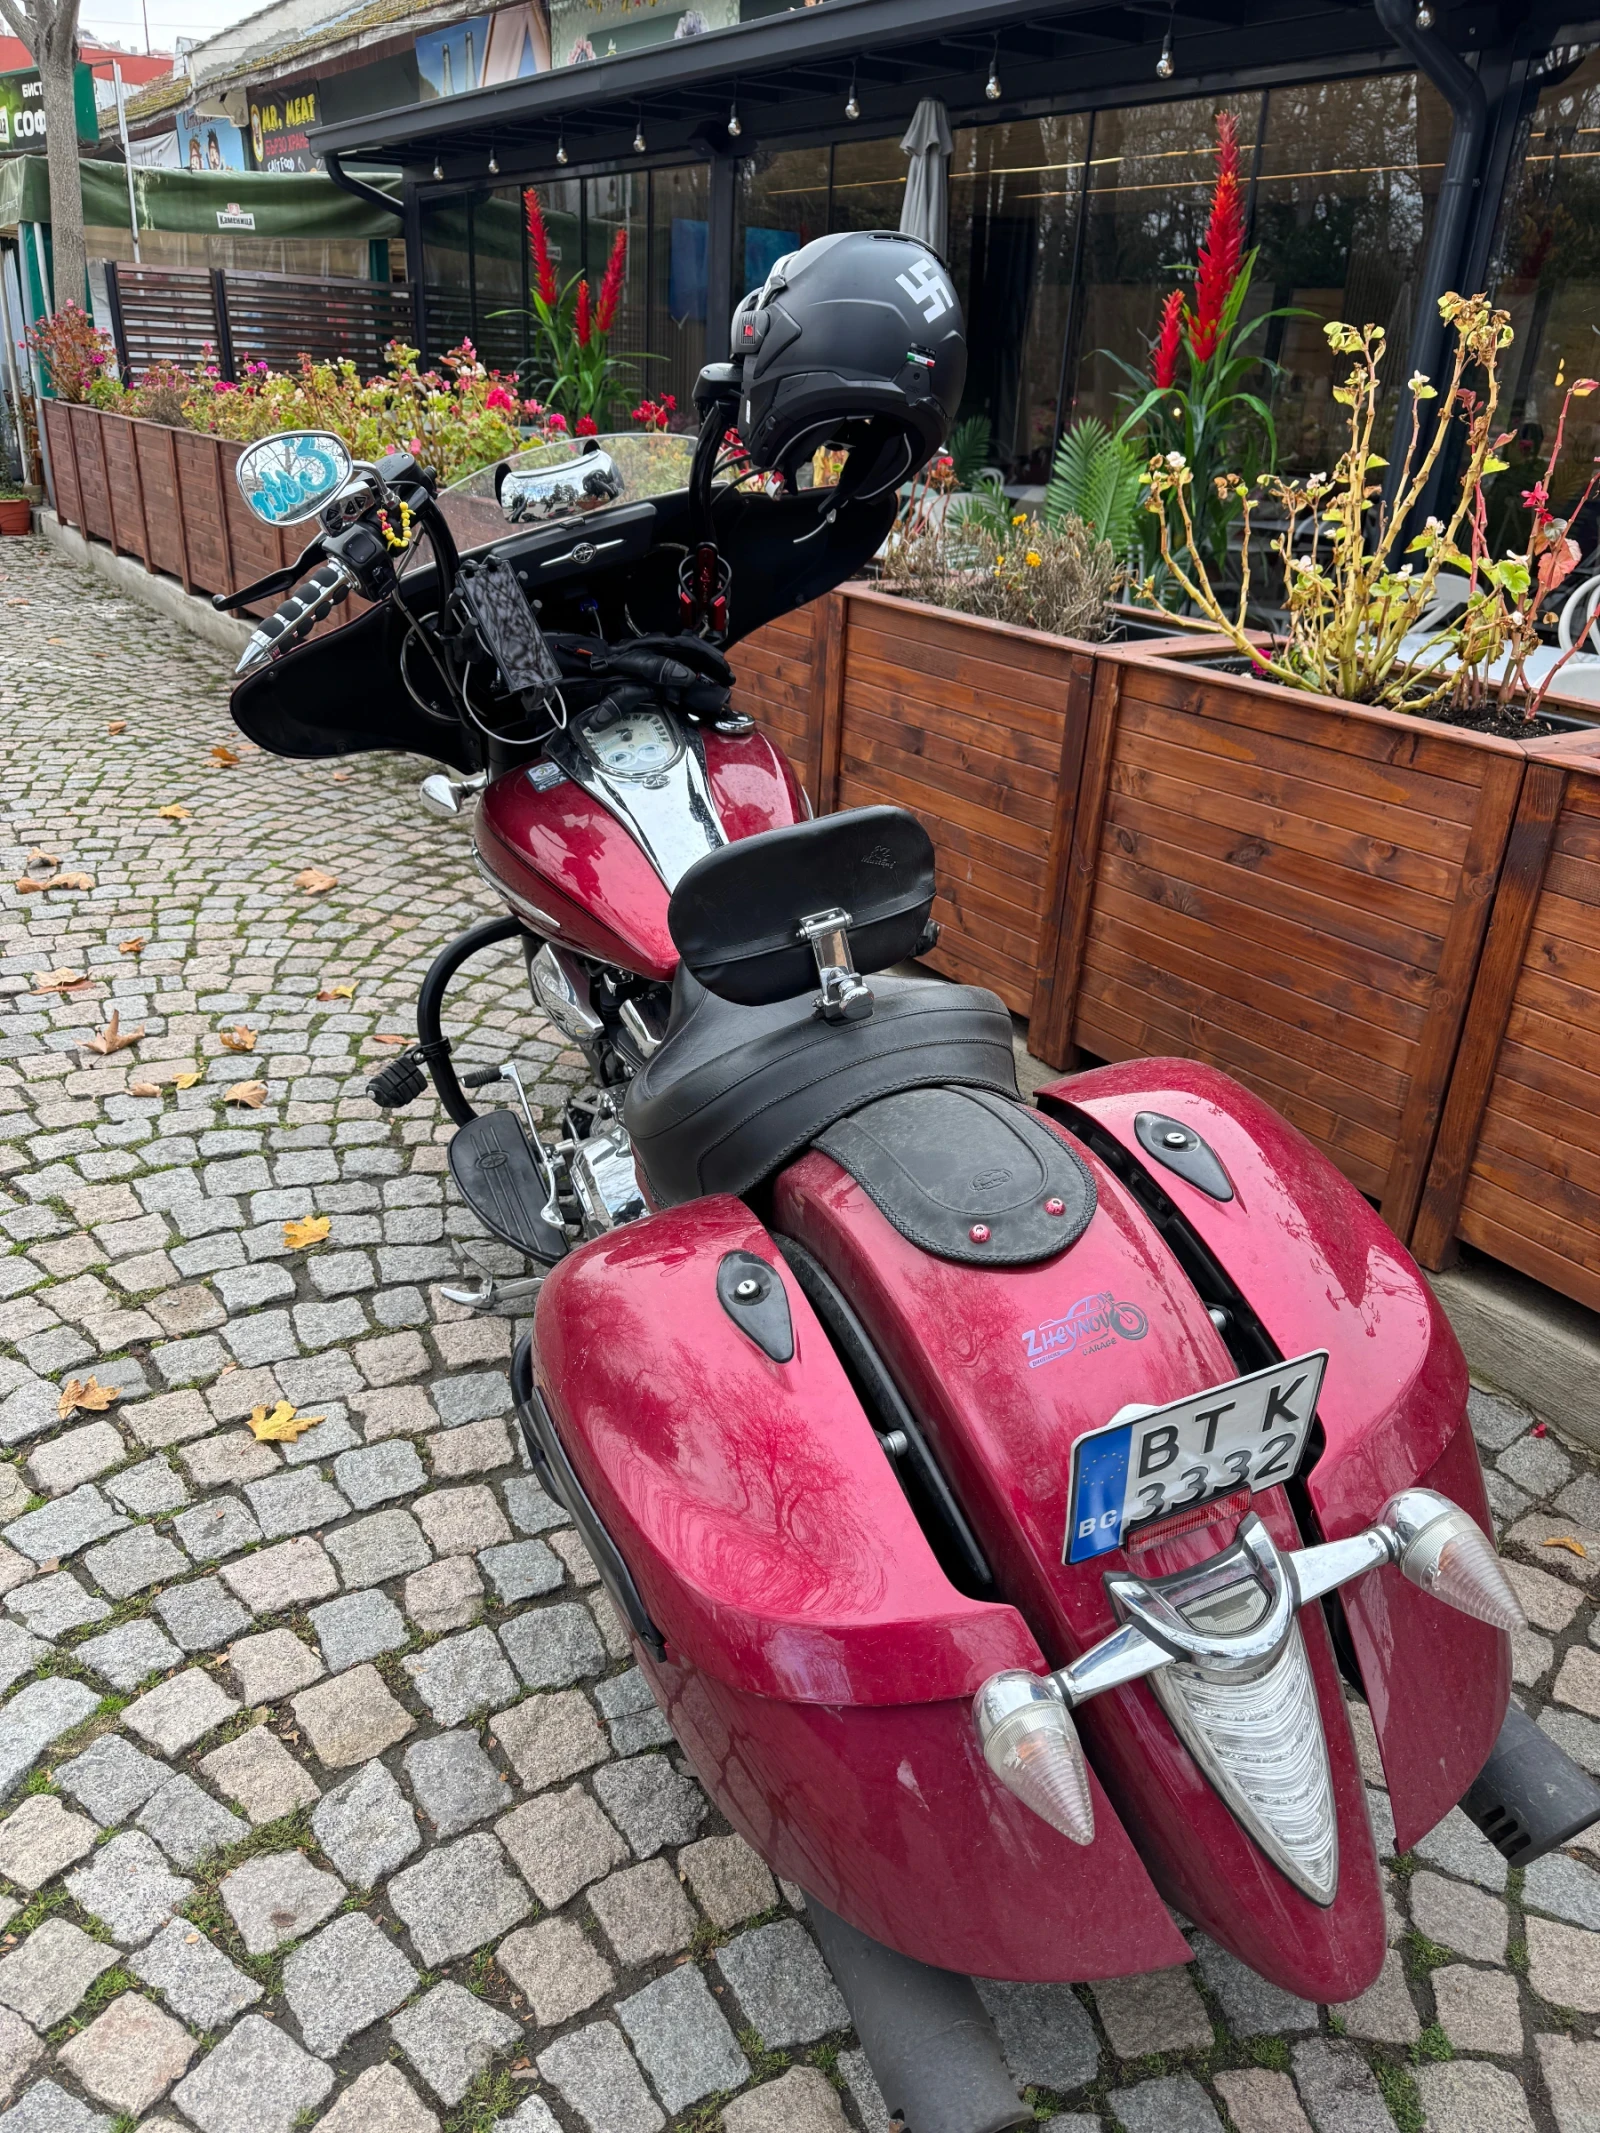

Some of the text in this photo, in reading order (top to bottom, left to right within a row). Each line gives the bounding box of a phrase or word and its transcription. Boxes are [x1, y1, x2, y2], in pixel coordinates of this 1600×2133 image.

[22, 81, 43, 98] БИСТ
[14, 109, 47, 137] СОФ
[286, 93, 315, 128] MEAT
[280, 157, 295, 172] FOOD
[1082, 1337, 1117, 1356] GARAGE
[1129, 1431, 1298, 1523] 3332
[1078, 1510, 1118, 1539] BG
